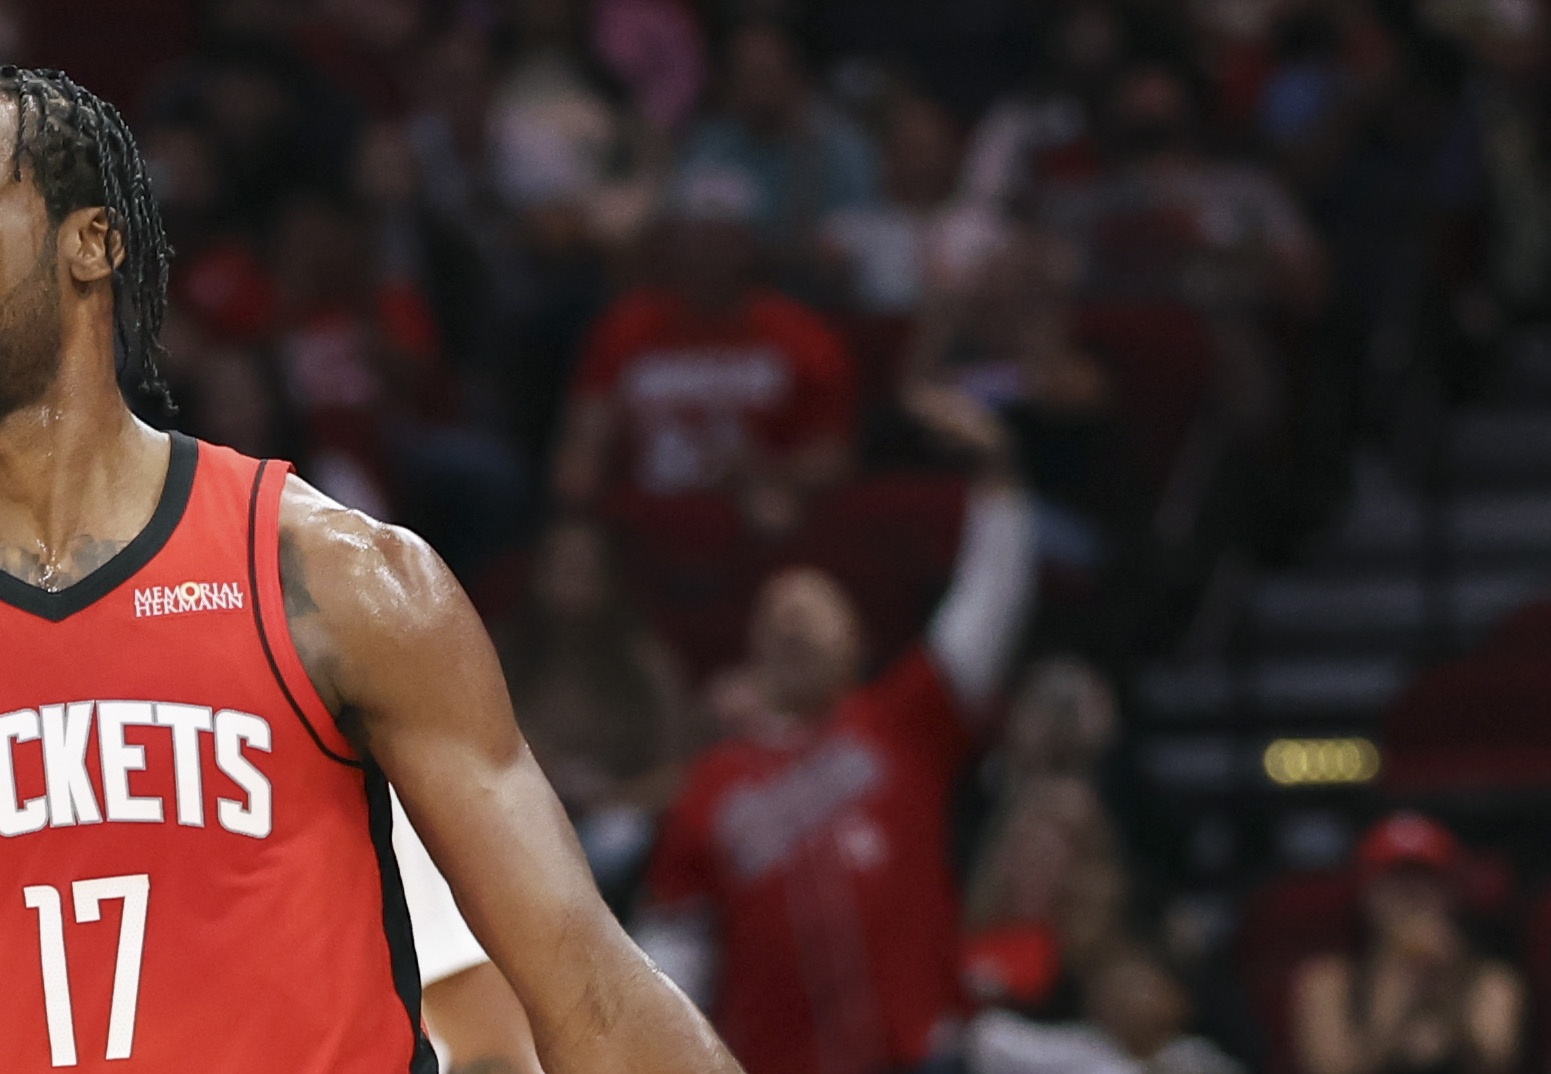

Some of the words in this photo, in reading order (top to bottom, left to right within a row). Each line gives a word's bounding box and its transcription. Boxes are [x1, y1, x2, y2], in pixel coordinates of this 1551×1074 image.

[134, 581, 243, 605] MEMORIAL
[134, 594, 244, 617] HERMANN
[23, 873, 150, 1067] 17
